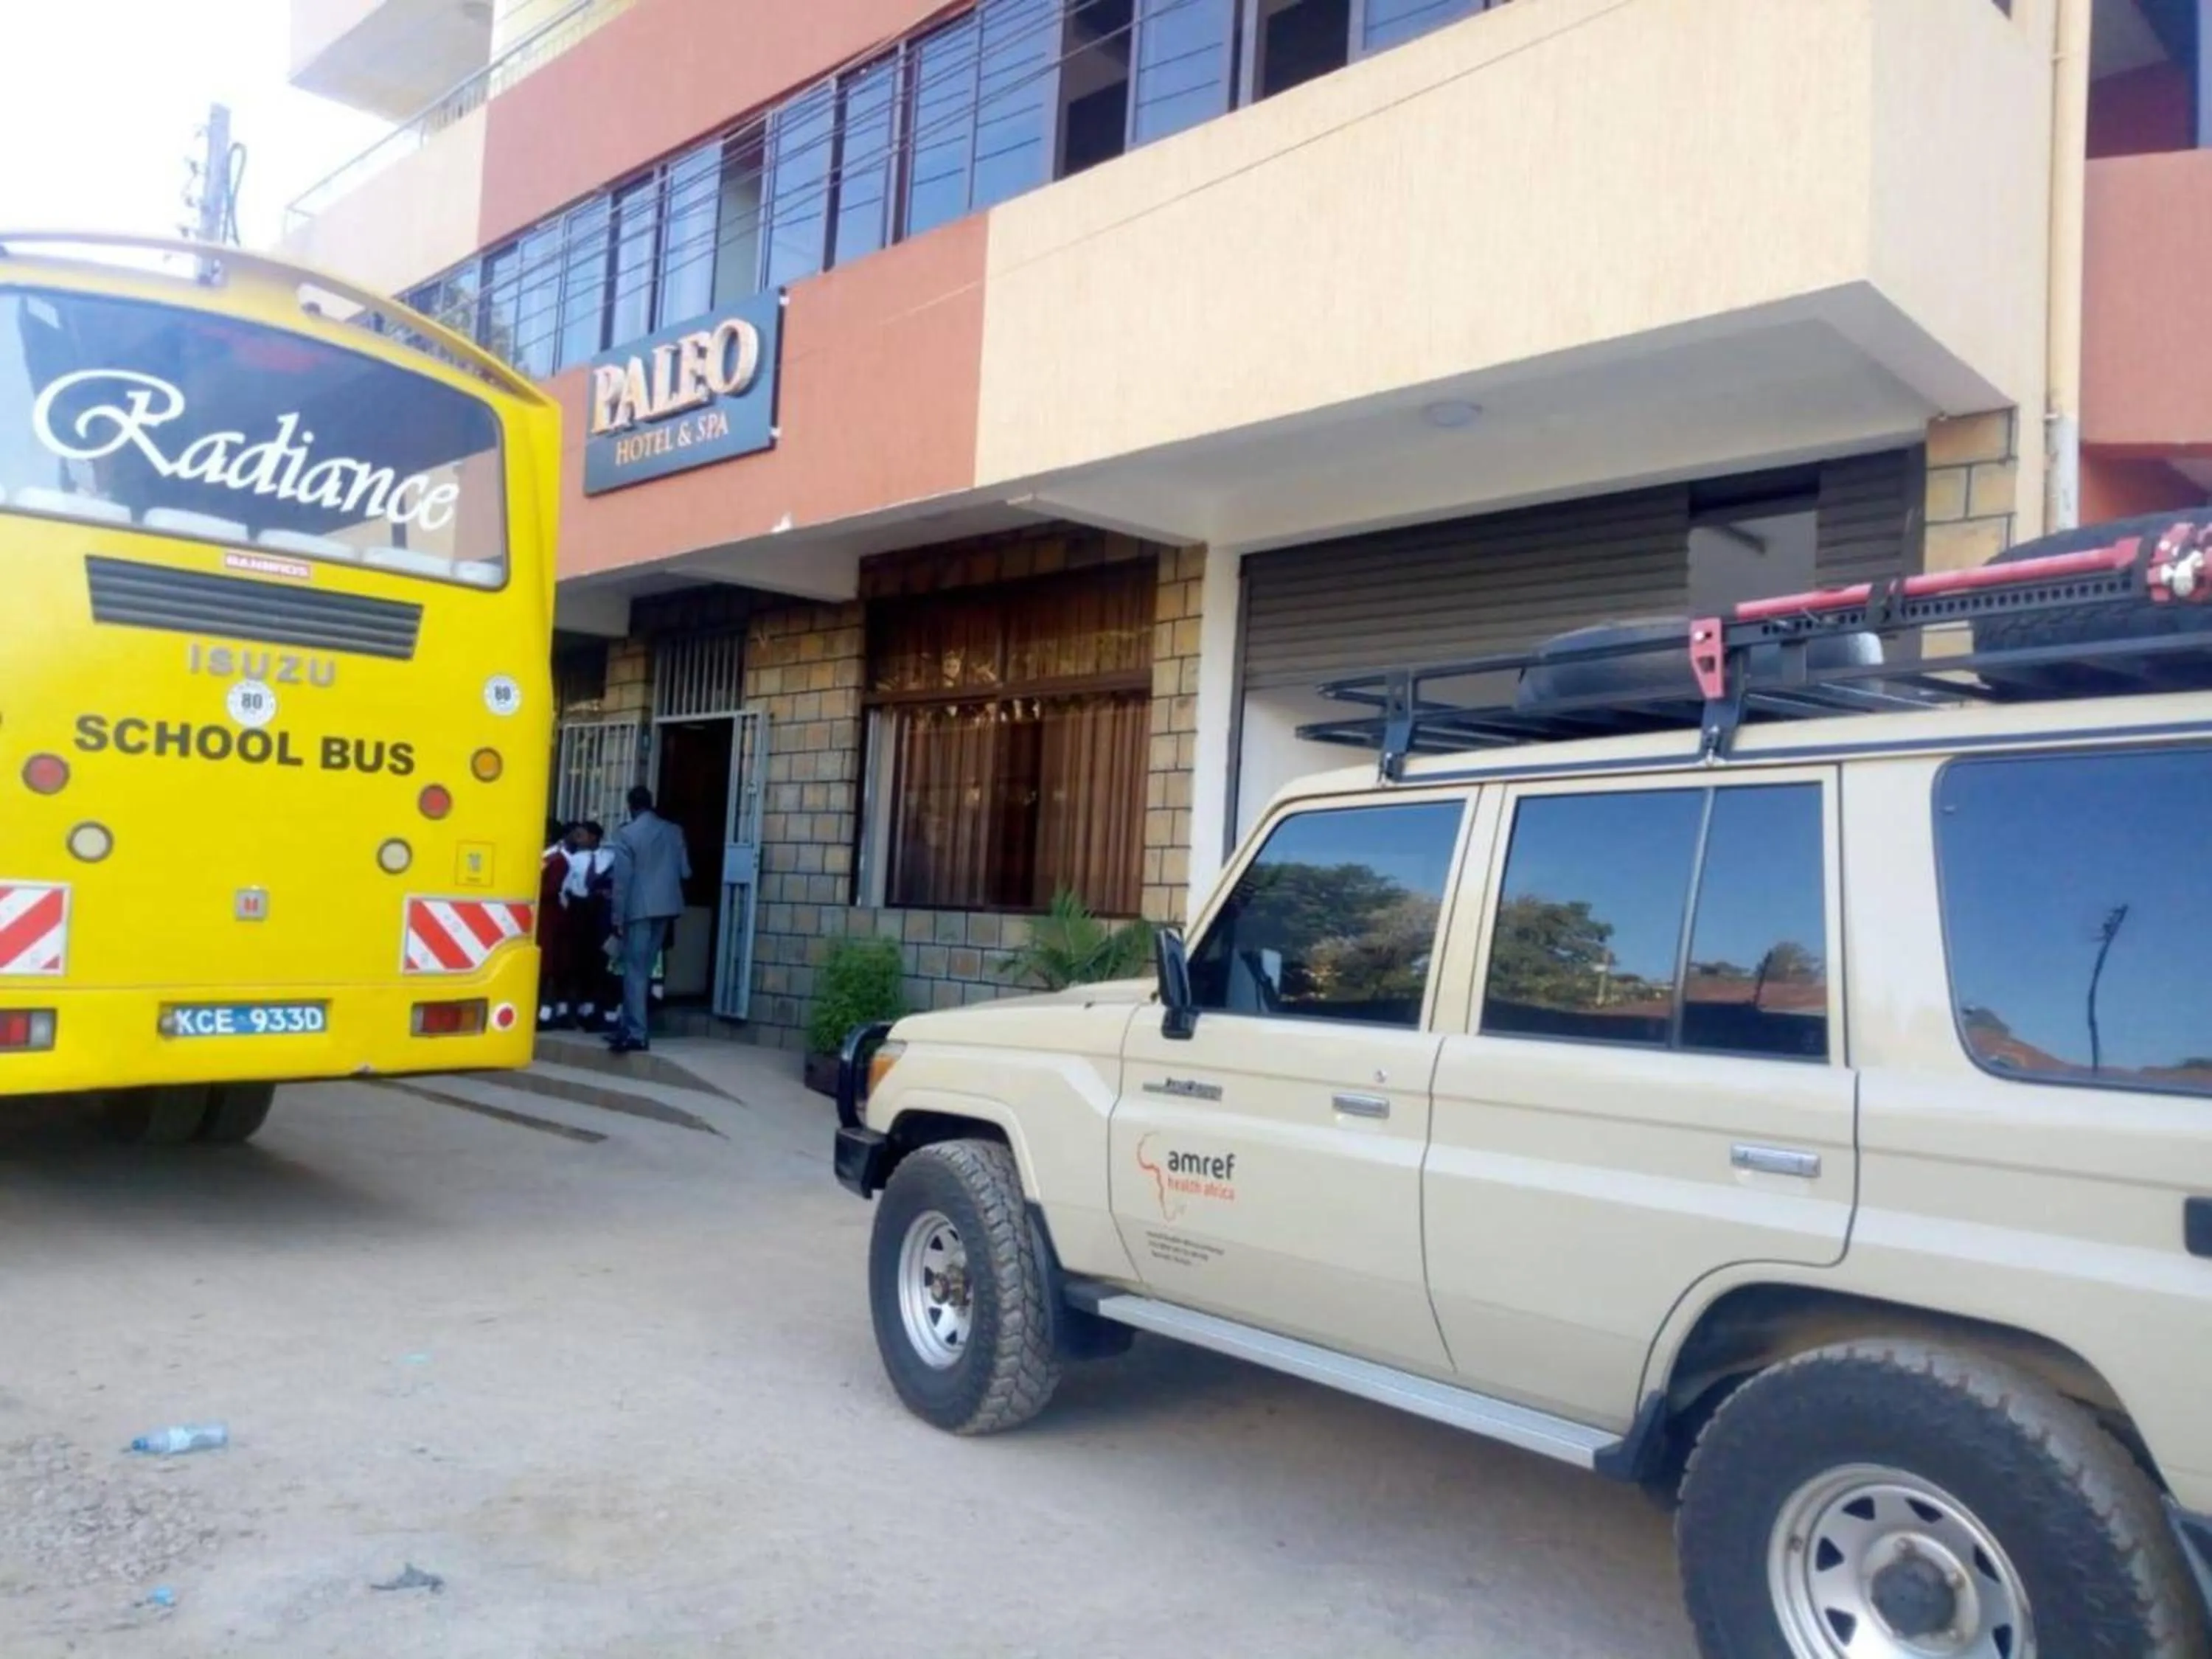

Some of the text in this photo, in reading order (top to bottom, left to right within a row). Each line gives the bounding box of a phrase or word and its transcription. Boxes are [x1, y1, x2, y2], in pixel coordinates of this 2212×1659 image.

[591, 318, 759, 433] PALEO
[32, 369, 460, 530] Radiance
[616, 411, 728, 465] HOTEL & SPA
[189, 644, 335, 688] ISUZU
[240, 692, 263, 709] 80
[74, 714, 416, 776] SCHOOL BUS
[174, 1006, 325, 1035] KCE 933D
[1168, 1150, 1235, 1180] amref
